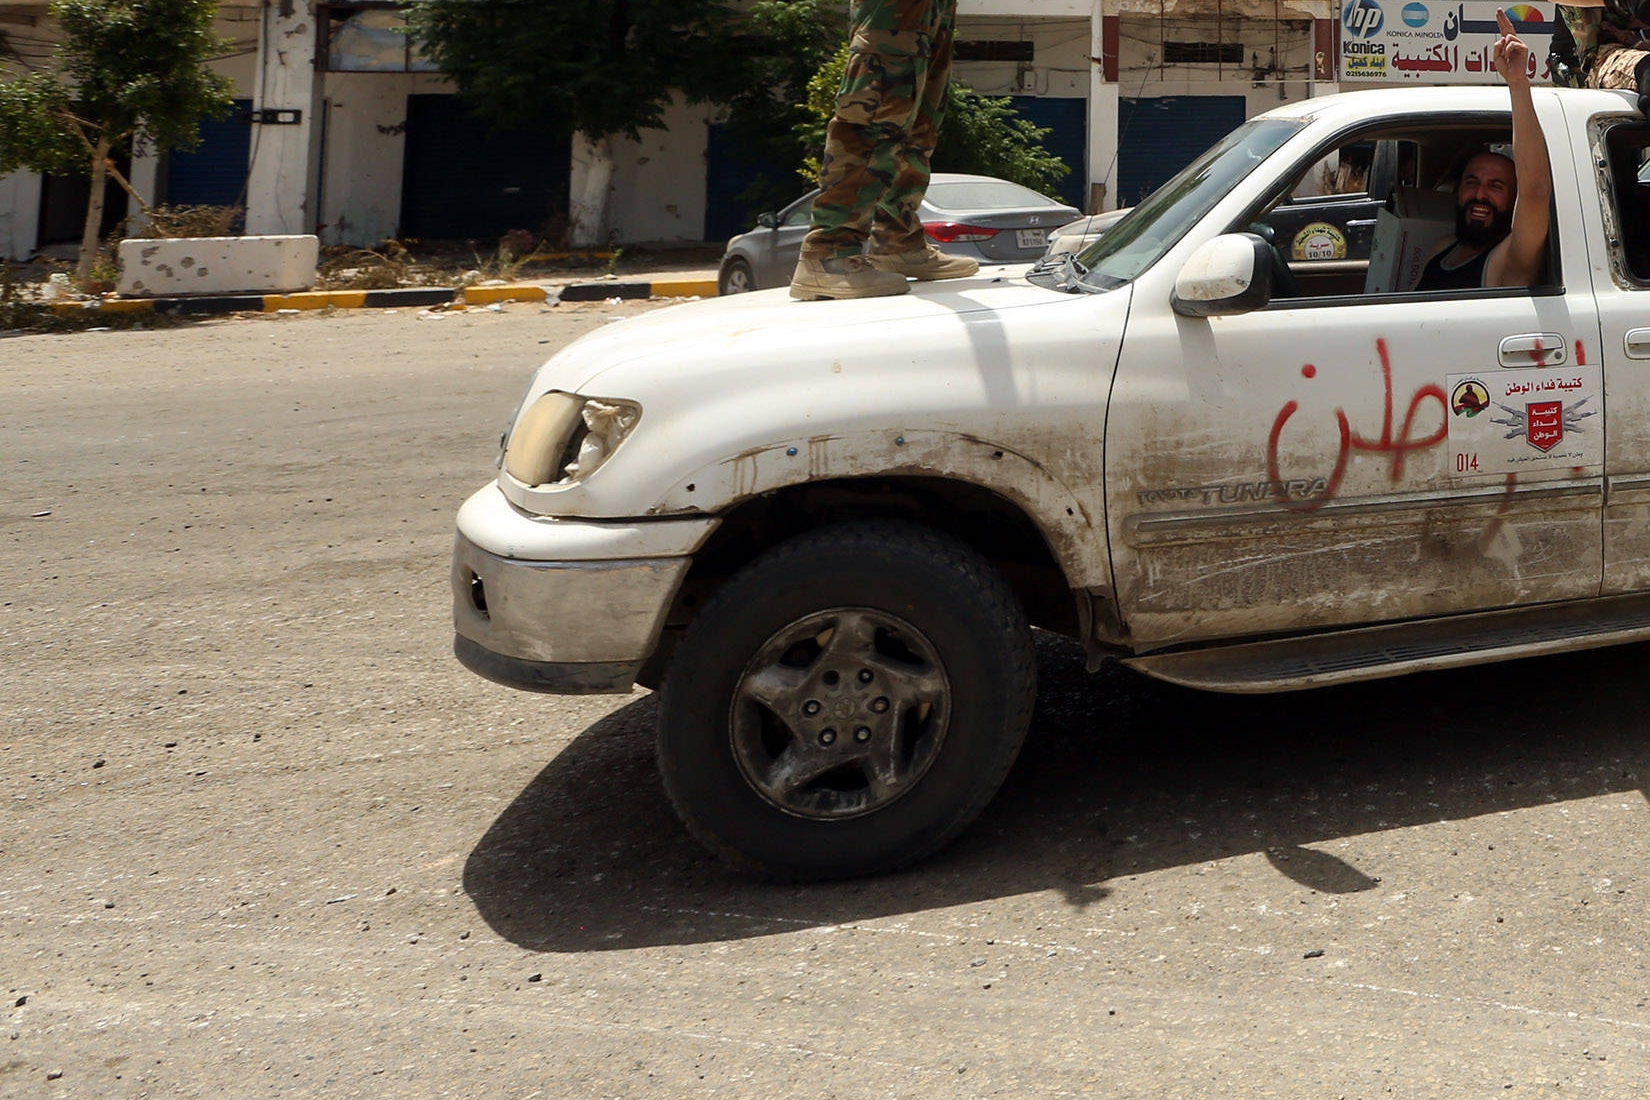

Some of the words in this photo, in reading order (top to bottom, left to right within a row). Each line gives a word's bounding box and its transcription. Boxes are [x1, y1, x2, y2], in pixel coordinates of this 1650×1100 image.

[1346, 0, 1382, 38] hp
[1343, 41, 1385, 54] Konica
[1392, 43, 1458, 78] المكتبية
[1505, 382, 1534, 396] الوطن
[1536, 380, 1556, 391] فداء
[1558, 378, 1583, 392] كتيبة
[1533, 431, 1558, 441] الوطن
[1457, 453, 1479, 472] 014
[1137, 489, 1197, 504] TOYOTA
[1199, 478, 1329, 505] TUNDRA
